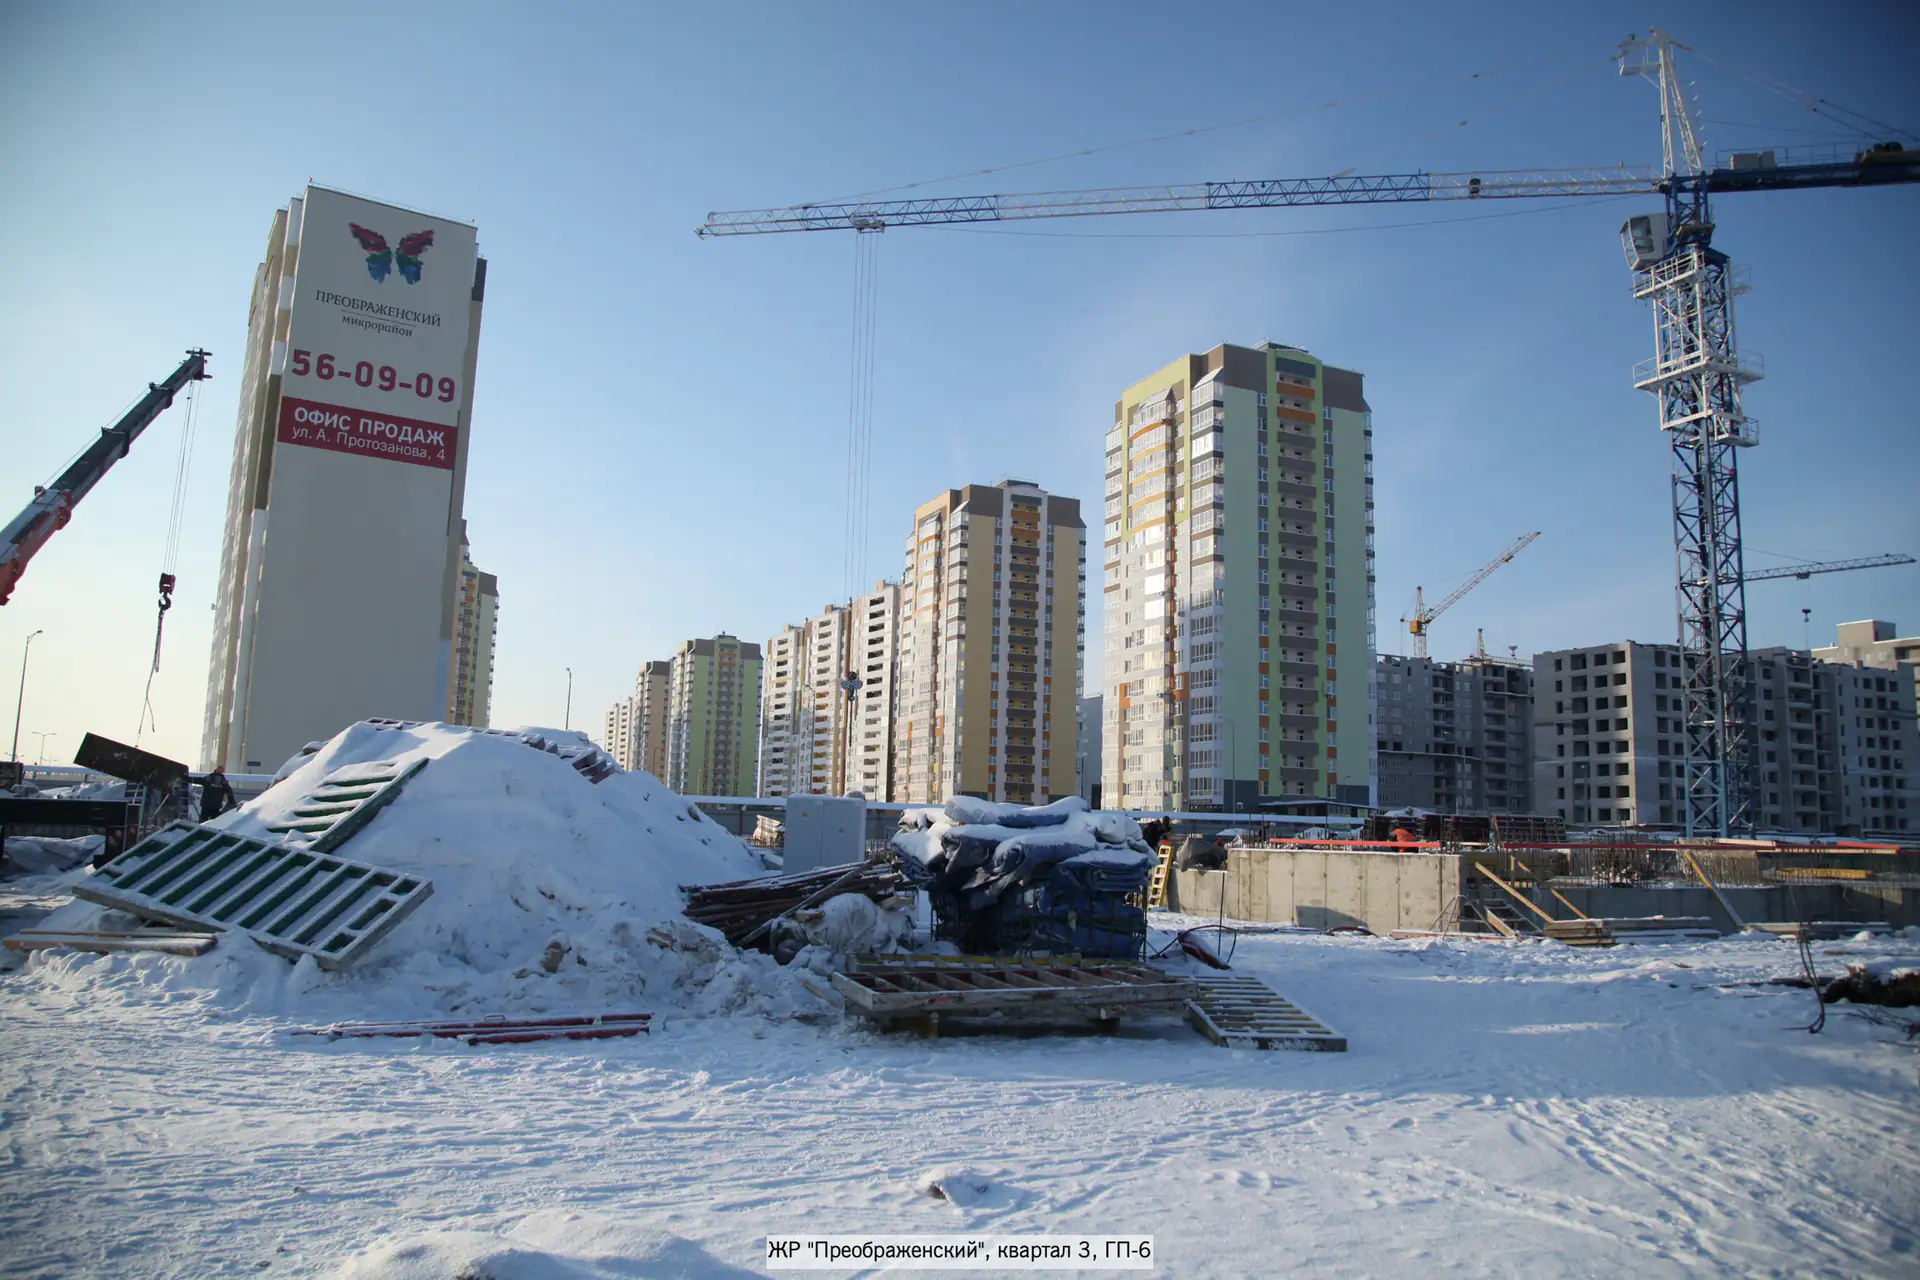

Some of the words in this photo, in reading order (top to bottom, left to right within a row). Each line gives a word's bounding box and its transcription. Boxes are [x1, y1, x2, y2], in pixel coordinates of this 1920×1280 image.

[316, 290, 441, 327] ПРЕОБРАЖЕНСКИЙ
[342, 316, 413, 337] микрорайон
[292, 349, 455, 402] 56-09-09
[292, 427, 312, 439] ул.
[316, 428, 330, 442] А.
[436, 449, 445, 460] 4
[294, 407, 351, 430] ОФИС
[359, 418, 445, 447] ПРОДАЖ
